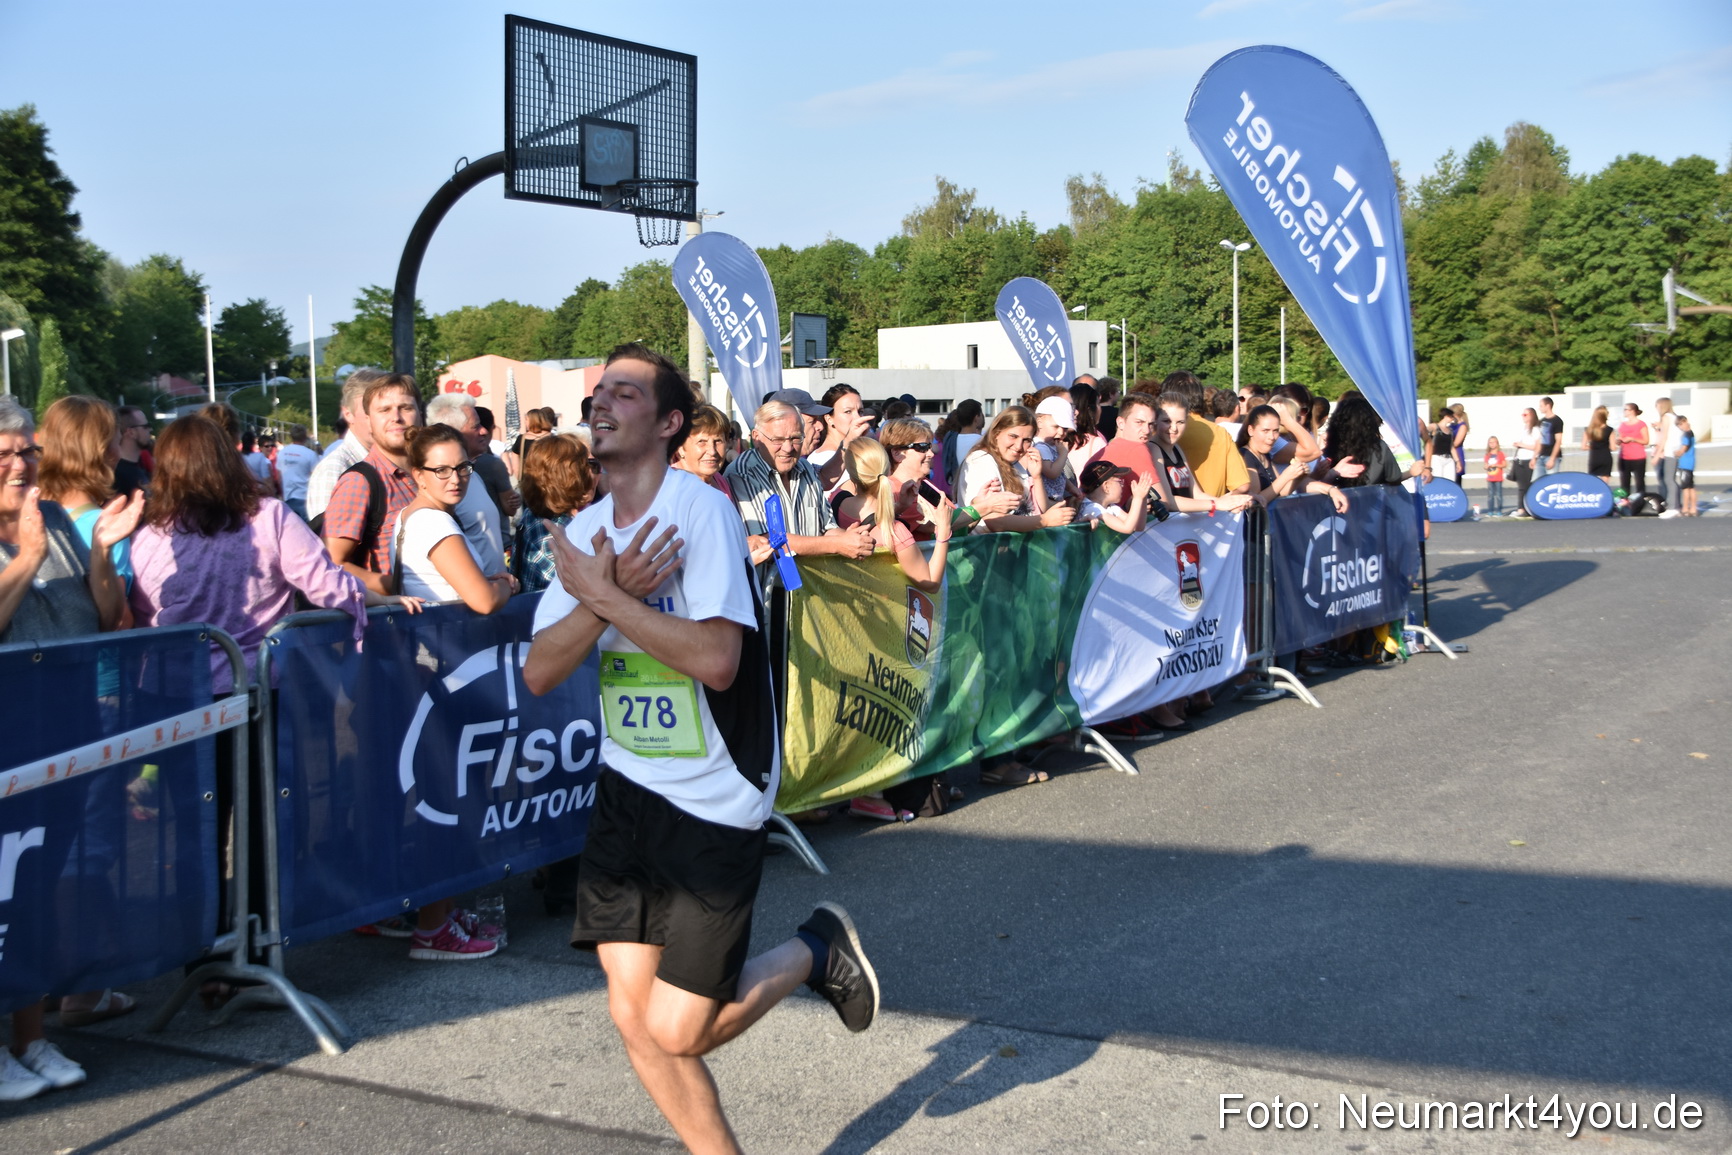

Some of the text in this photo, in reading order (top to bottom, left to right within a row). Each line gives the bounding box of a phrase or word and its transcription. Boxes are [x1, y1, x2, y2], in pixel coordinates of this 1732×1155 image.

[1548, 491, 1603, 505] Fischer
[1325, 588, 1382, 618] AUTOMOBILE
[618, 694, 677, 729] 278
[457, 716, 602, 798] Fisc
